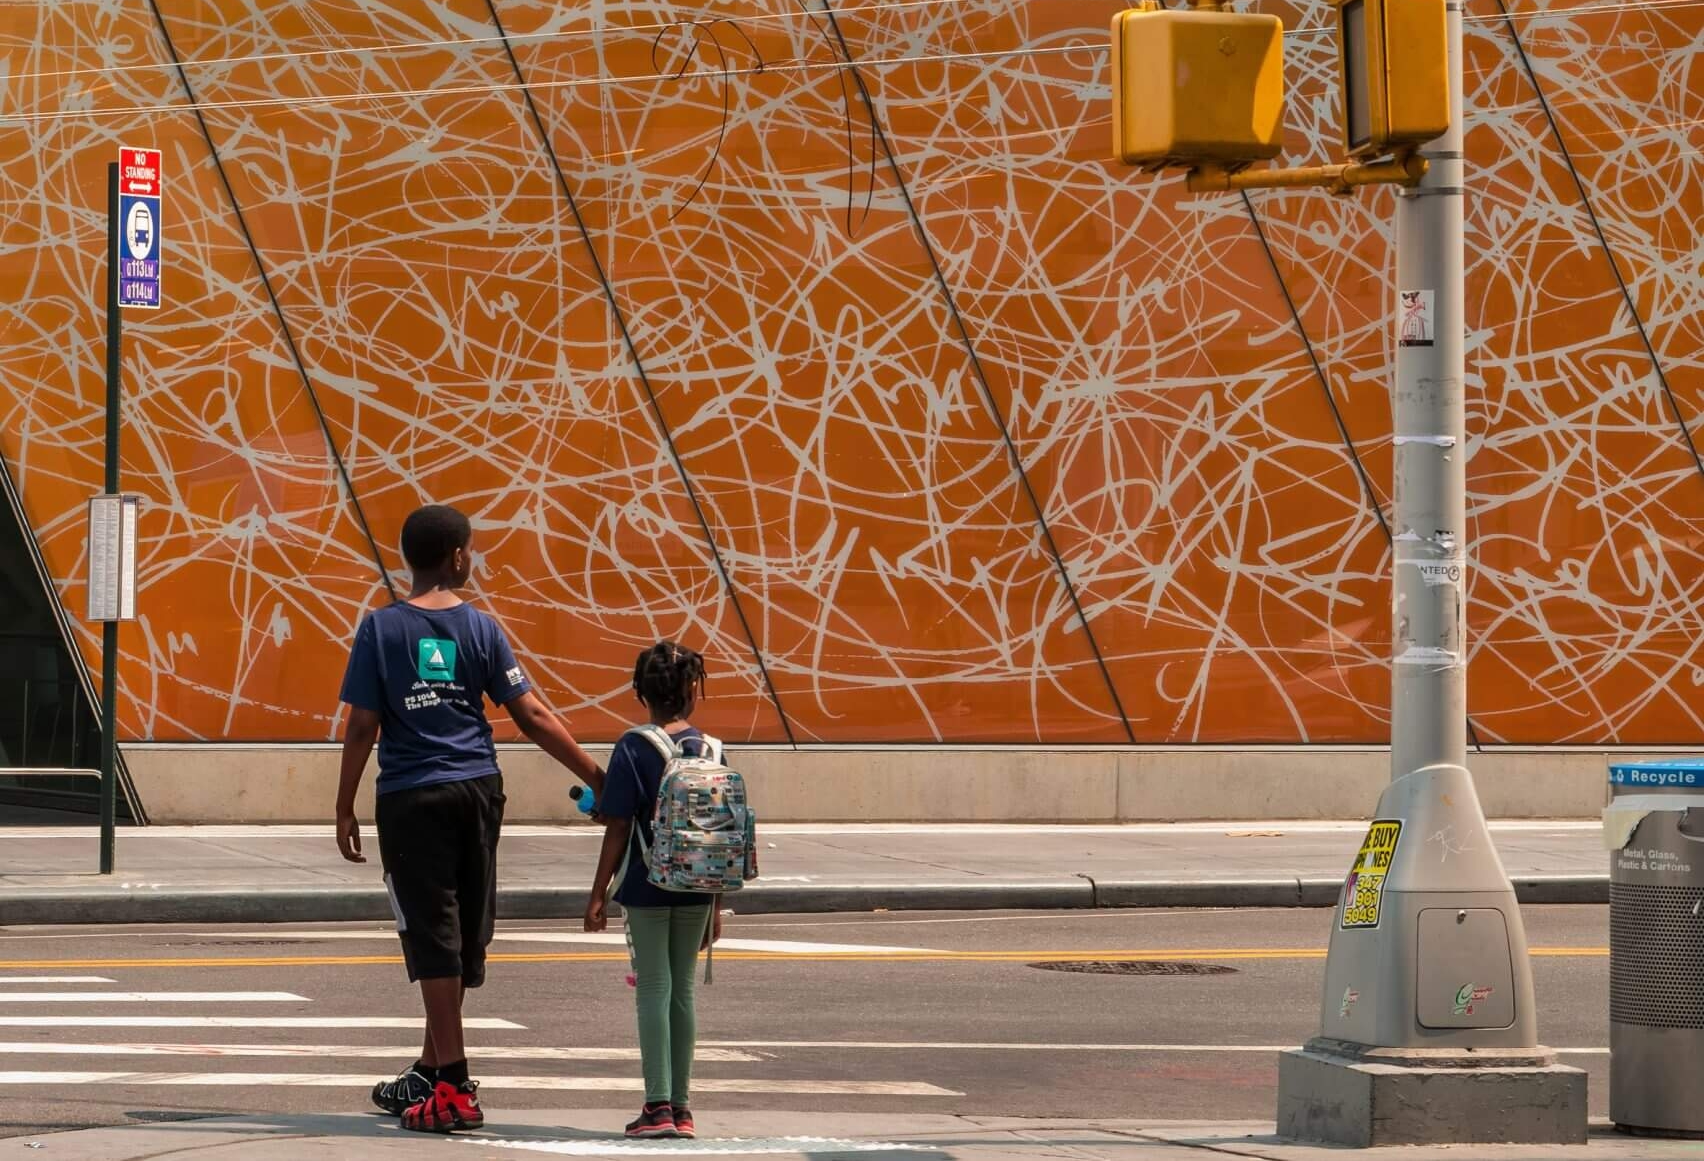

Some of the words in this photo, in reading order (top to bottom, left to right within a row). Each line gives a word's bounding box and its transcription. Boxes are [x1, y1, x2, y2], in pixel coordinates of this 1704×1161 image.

[134, 152, 146, 166] NO
[125, 166, 156, 181] STANDING
[405, 703, 421, 711] The
[1631, 770, 1696, 785] Recycle
[1373, 827, 1398, 848] BUY
[1623, 848, 1646, 860] Metal,
[1648, 849, 1679, 861] Glass,
[1618, 859, 1640, 870] Plastic
[1641, 861, 1648, 871] &
[1650, 861, 1691, 872] Cartons
[1356, 875, 1384, 891] 347
[1355, 890, 1379, 907] 901
[1344, 907, 1377, 924] 5049
